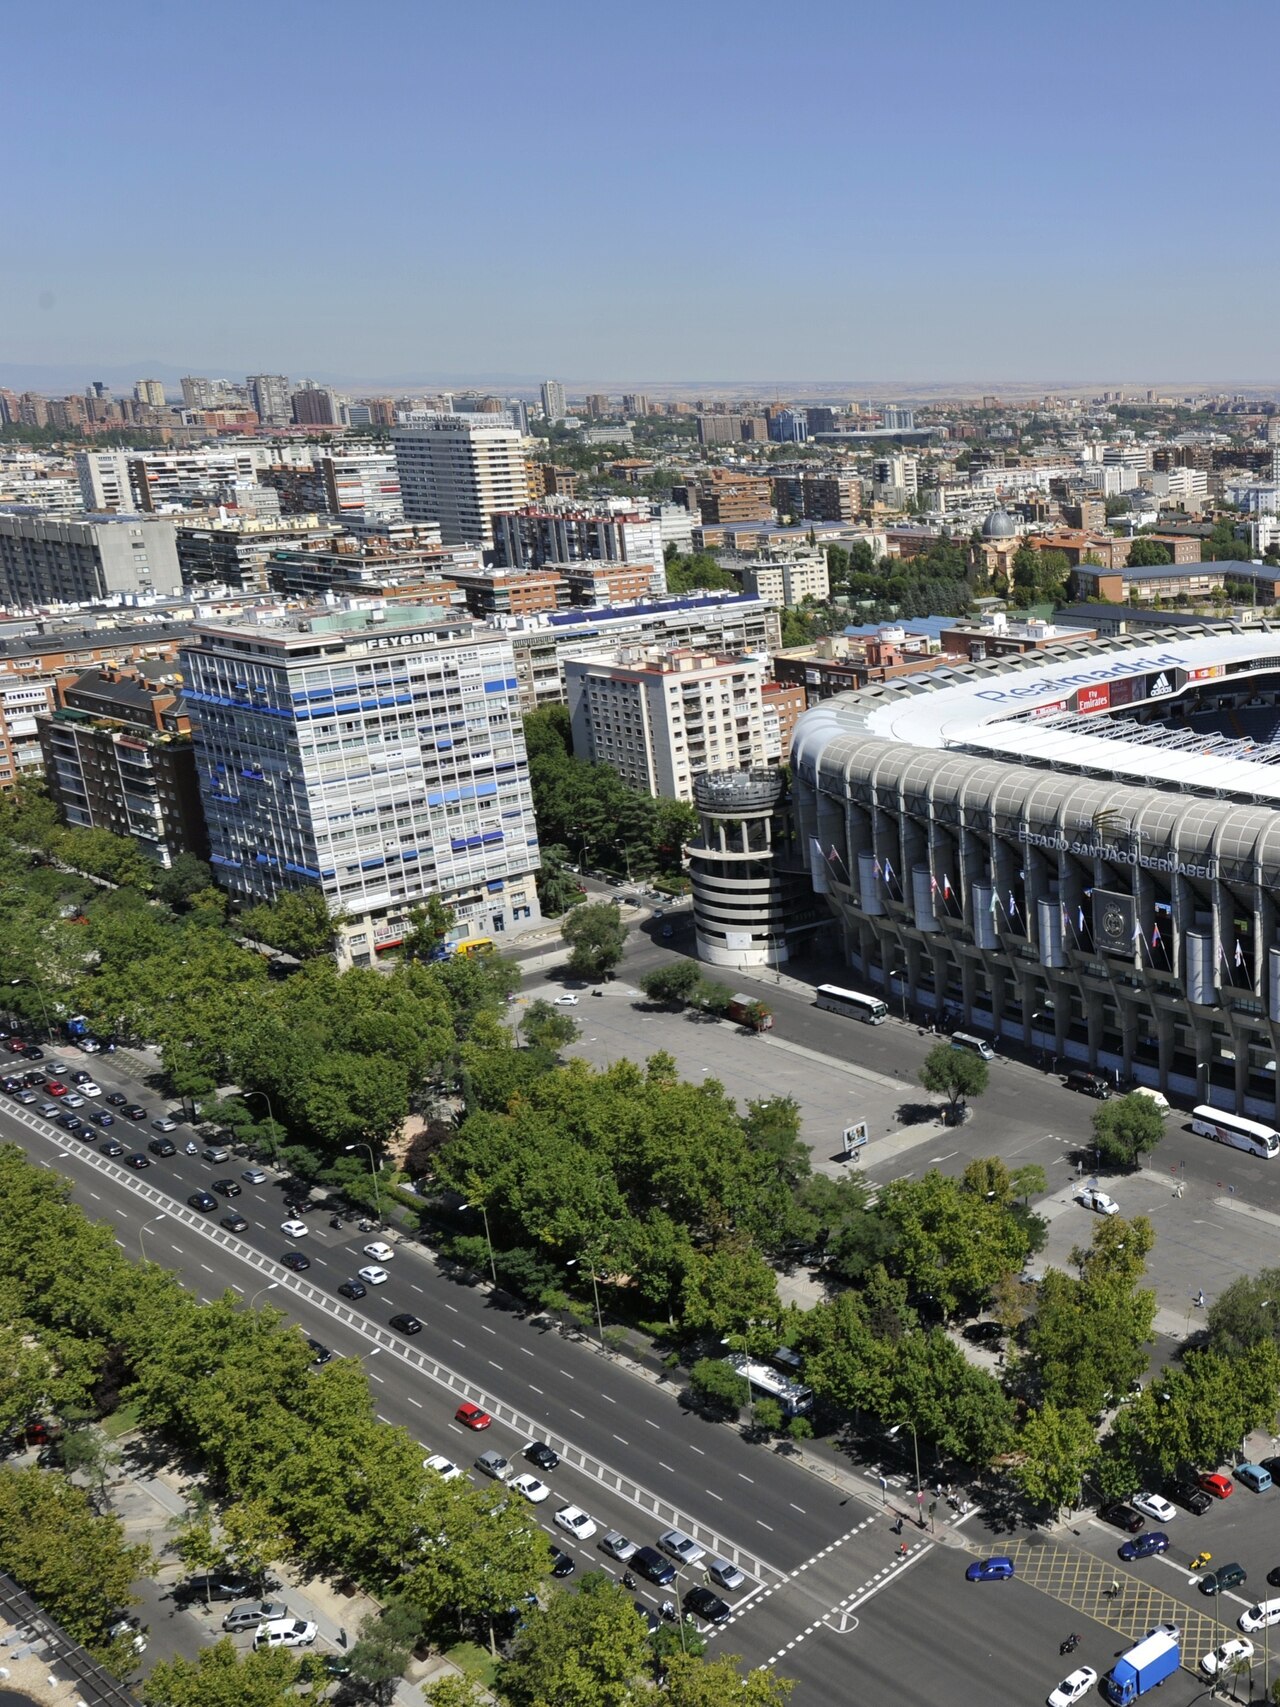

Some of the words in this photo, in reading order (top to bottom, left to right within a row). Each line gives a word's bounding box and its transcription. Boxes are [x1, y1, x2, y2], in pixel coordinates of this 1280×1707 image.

[405, 413, 461, 423] Eurobuilding
[367, 632, 434, 650] FEYGON
[1088, 690, 1098, 698] Fly
[1151, 685, 1173, 697] adidas
[1079, 696, 1108, 710] Emirates
[1018, 832, 1068, 852] ESTADIO
[1071, 842, 1138, 865] SANTIAGO
